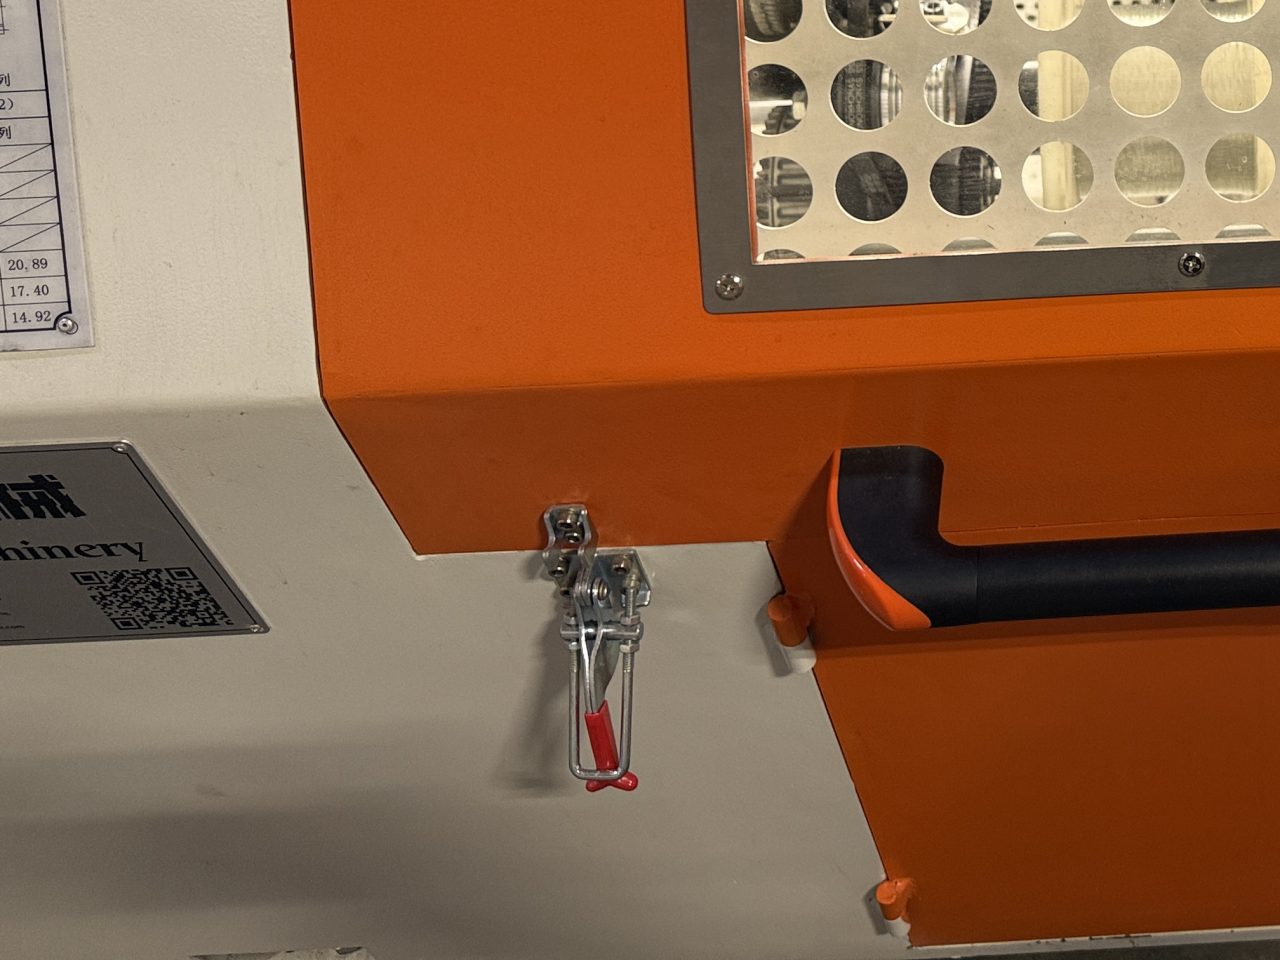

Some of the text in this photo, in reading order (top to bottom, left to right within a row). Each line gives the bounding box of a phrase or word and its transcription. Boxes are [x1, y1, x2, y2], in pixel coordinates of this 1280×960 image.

[8, 257, 48, 271] 20.89
[10, 284, 49, 297] 17.40
[12, 310, 52, 323] 14.92
